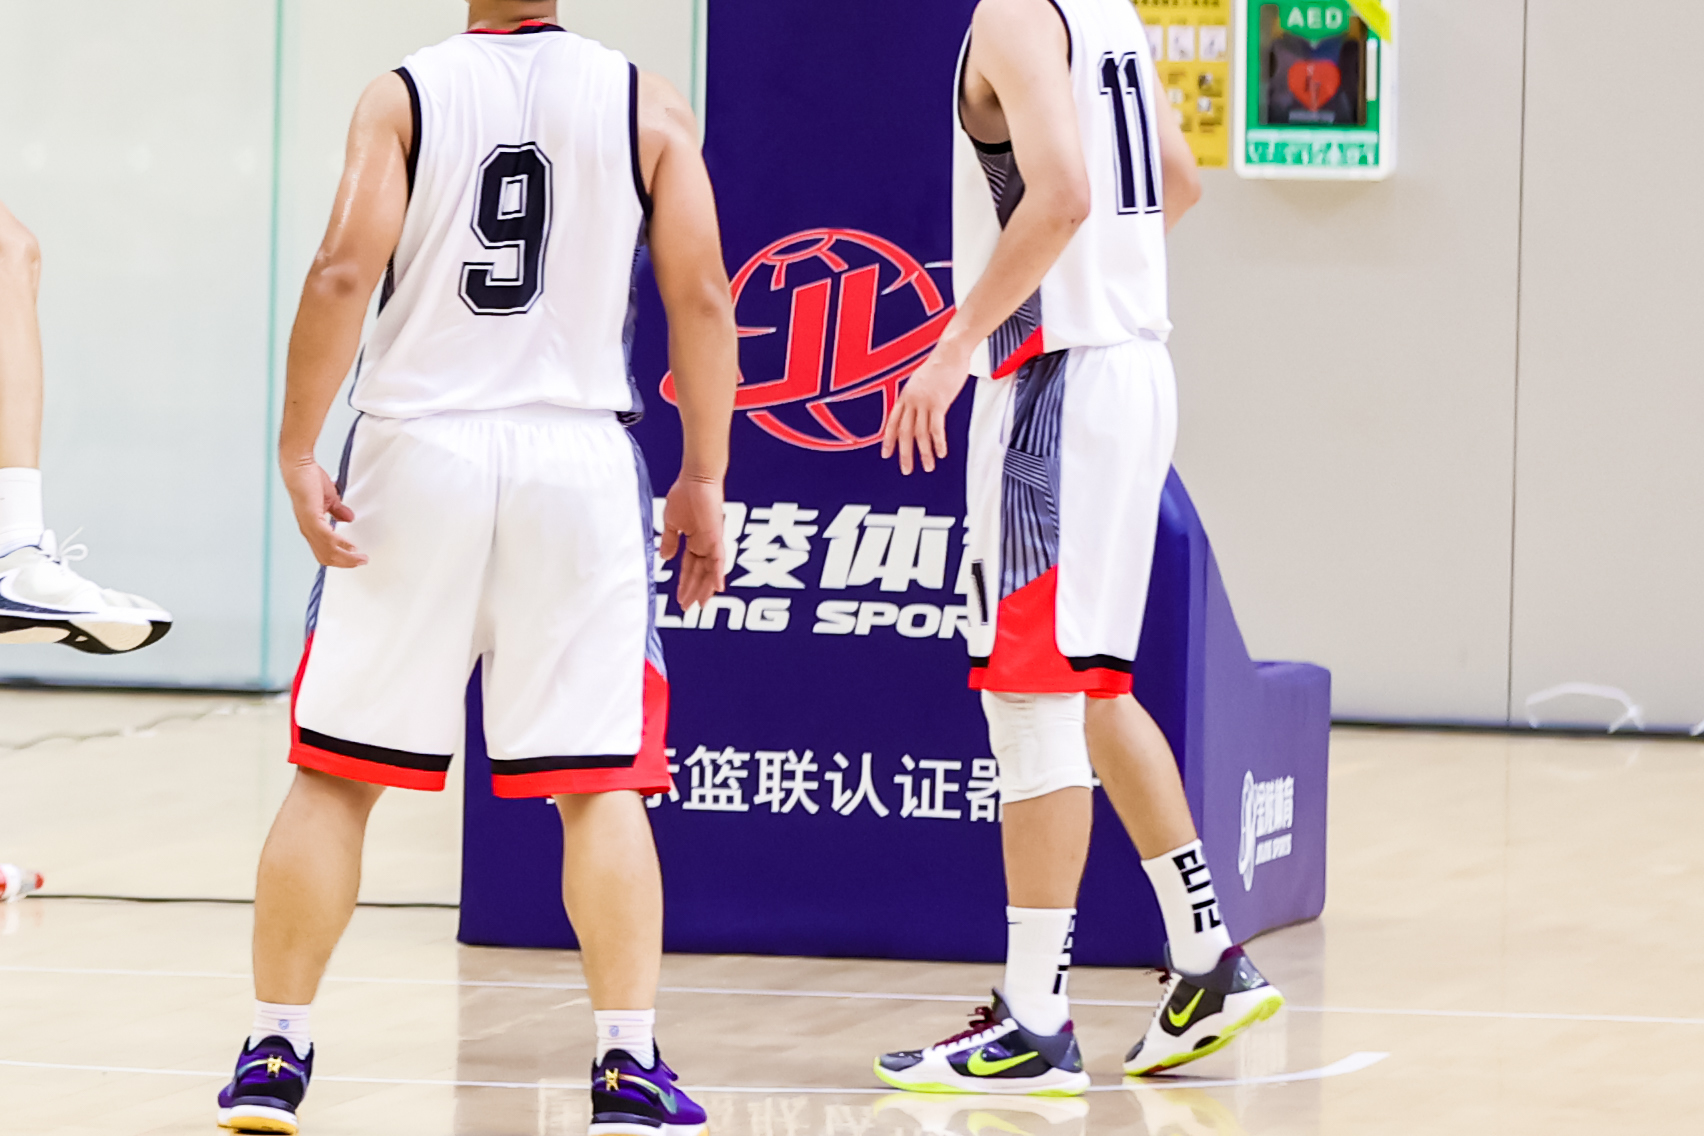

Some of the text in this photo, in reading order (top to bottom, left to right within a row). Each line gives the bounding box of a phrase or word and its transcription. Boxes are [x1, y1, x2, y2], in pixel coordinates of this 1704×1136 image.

[1287, 6, 1343, 30] AED
[1097, 51, 1163, 216] 11
[457, 140, 553, 316] 9
[655, 593, 968, 640] LING SPOR
